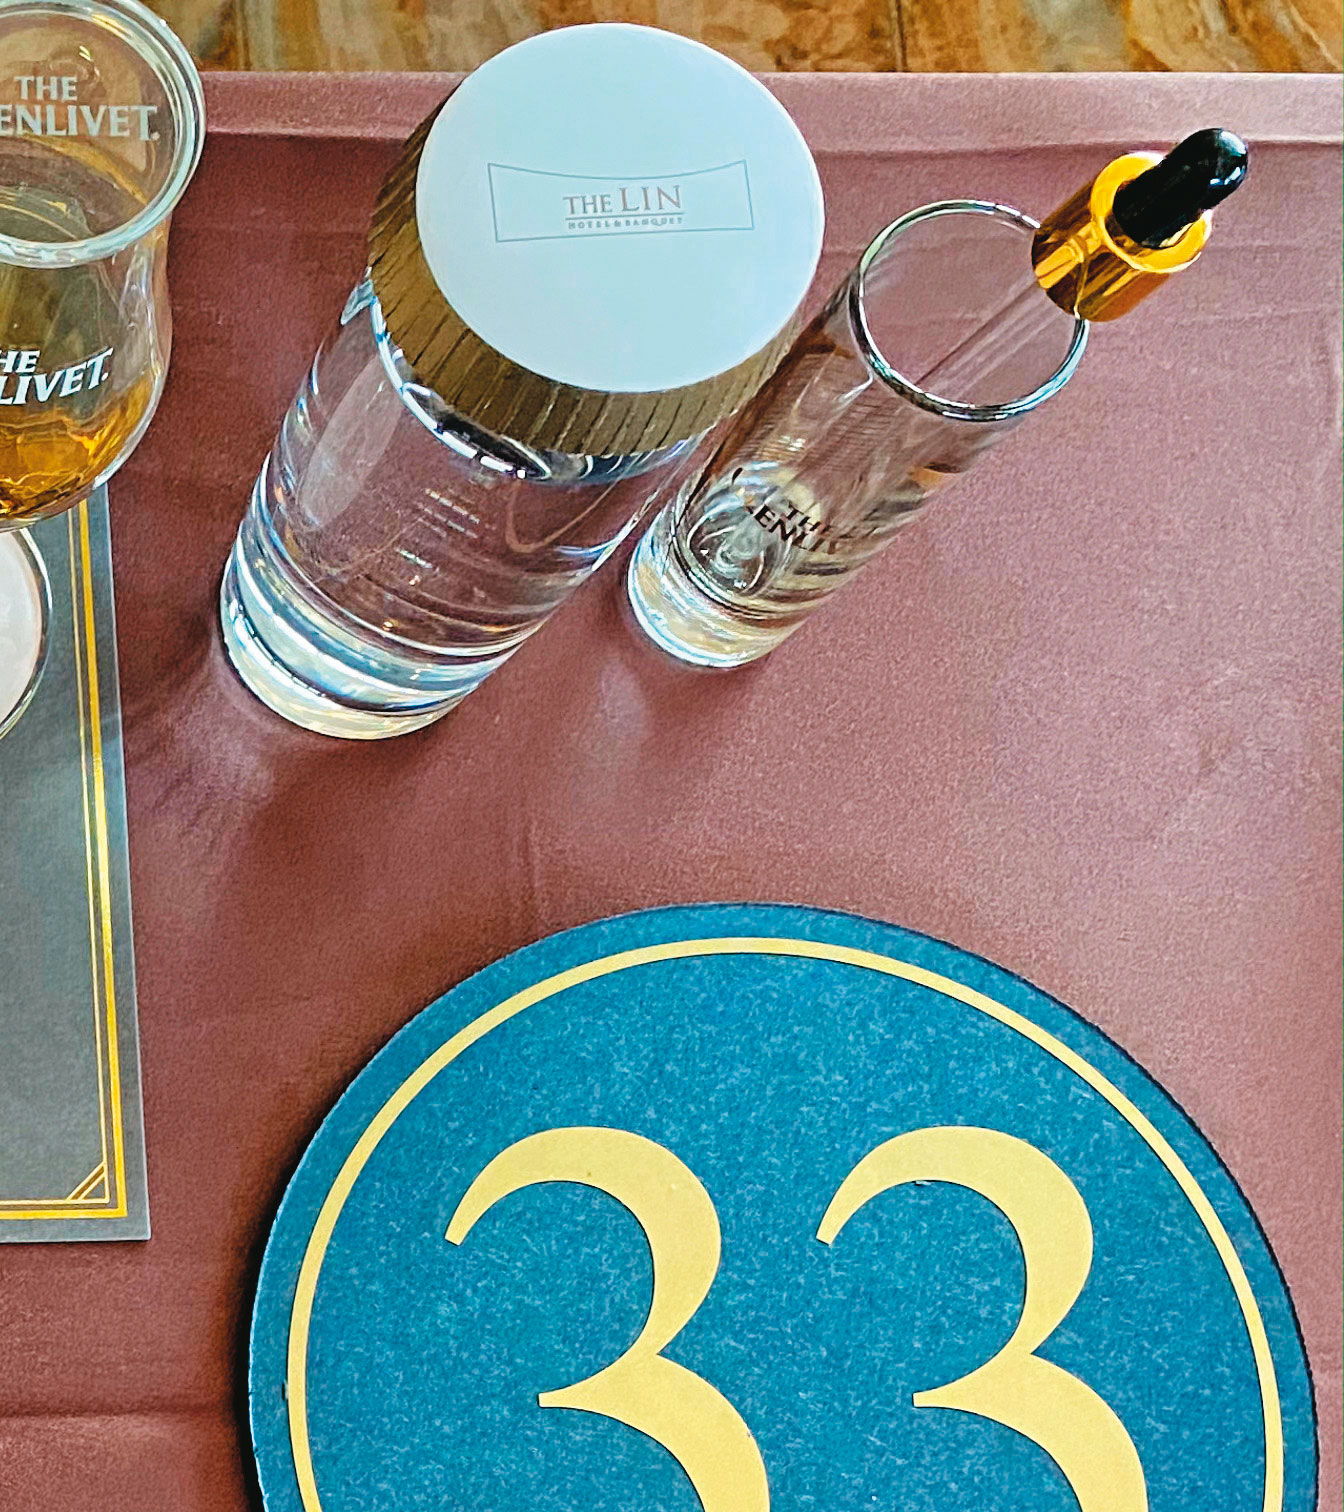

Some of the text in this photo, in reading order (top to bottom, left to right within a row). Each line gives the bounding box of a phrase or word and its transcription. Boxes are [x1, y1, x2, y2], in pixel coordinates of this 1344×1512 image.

[14, 75, 78, 102] THE
[562, 184, 682, 215] THE LIN
